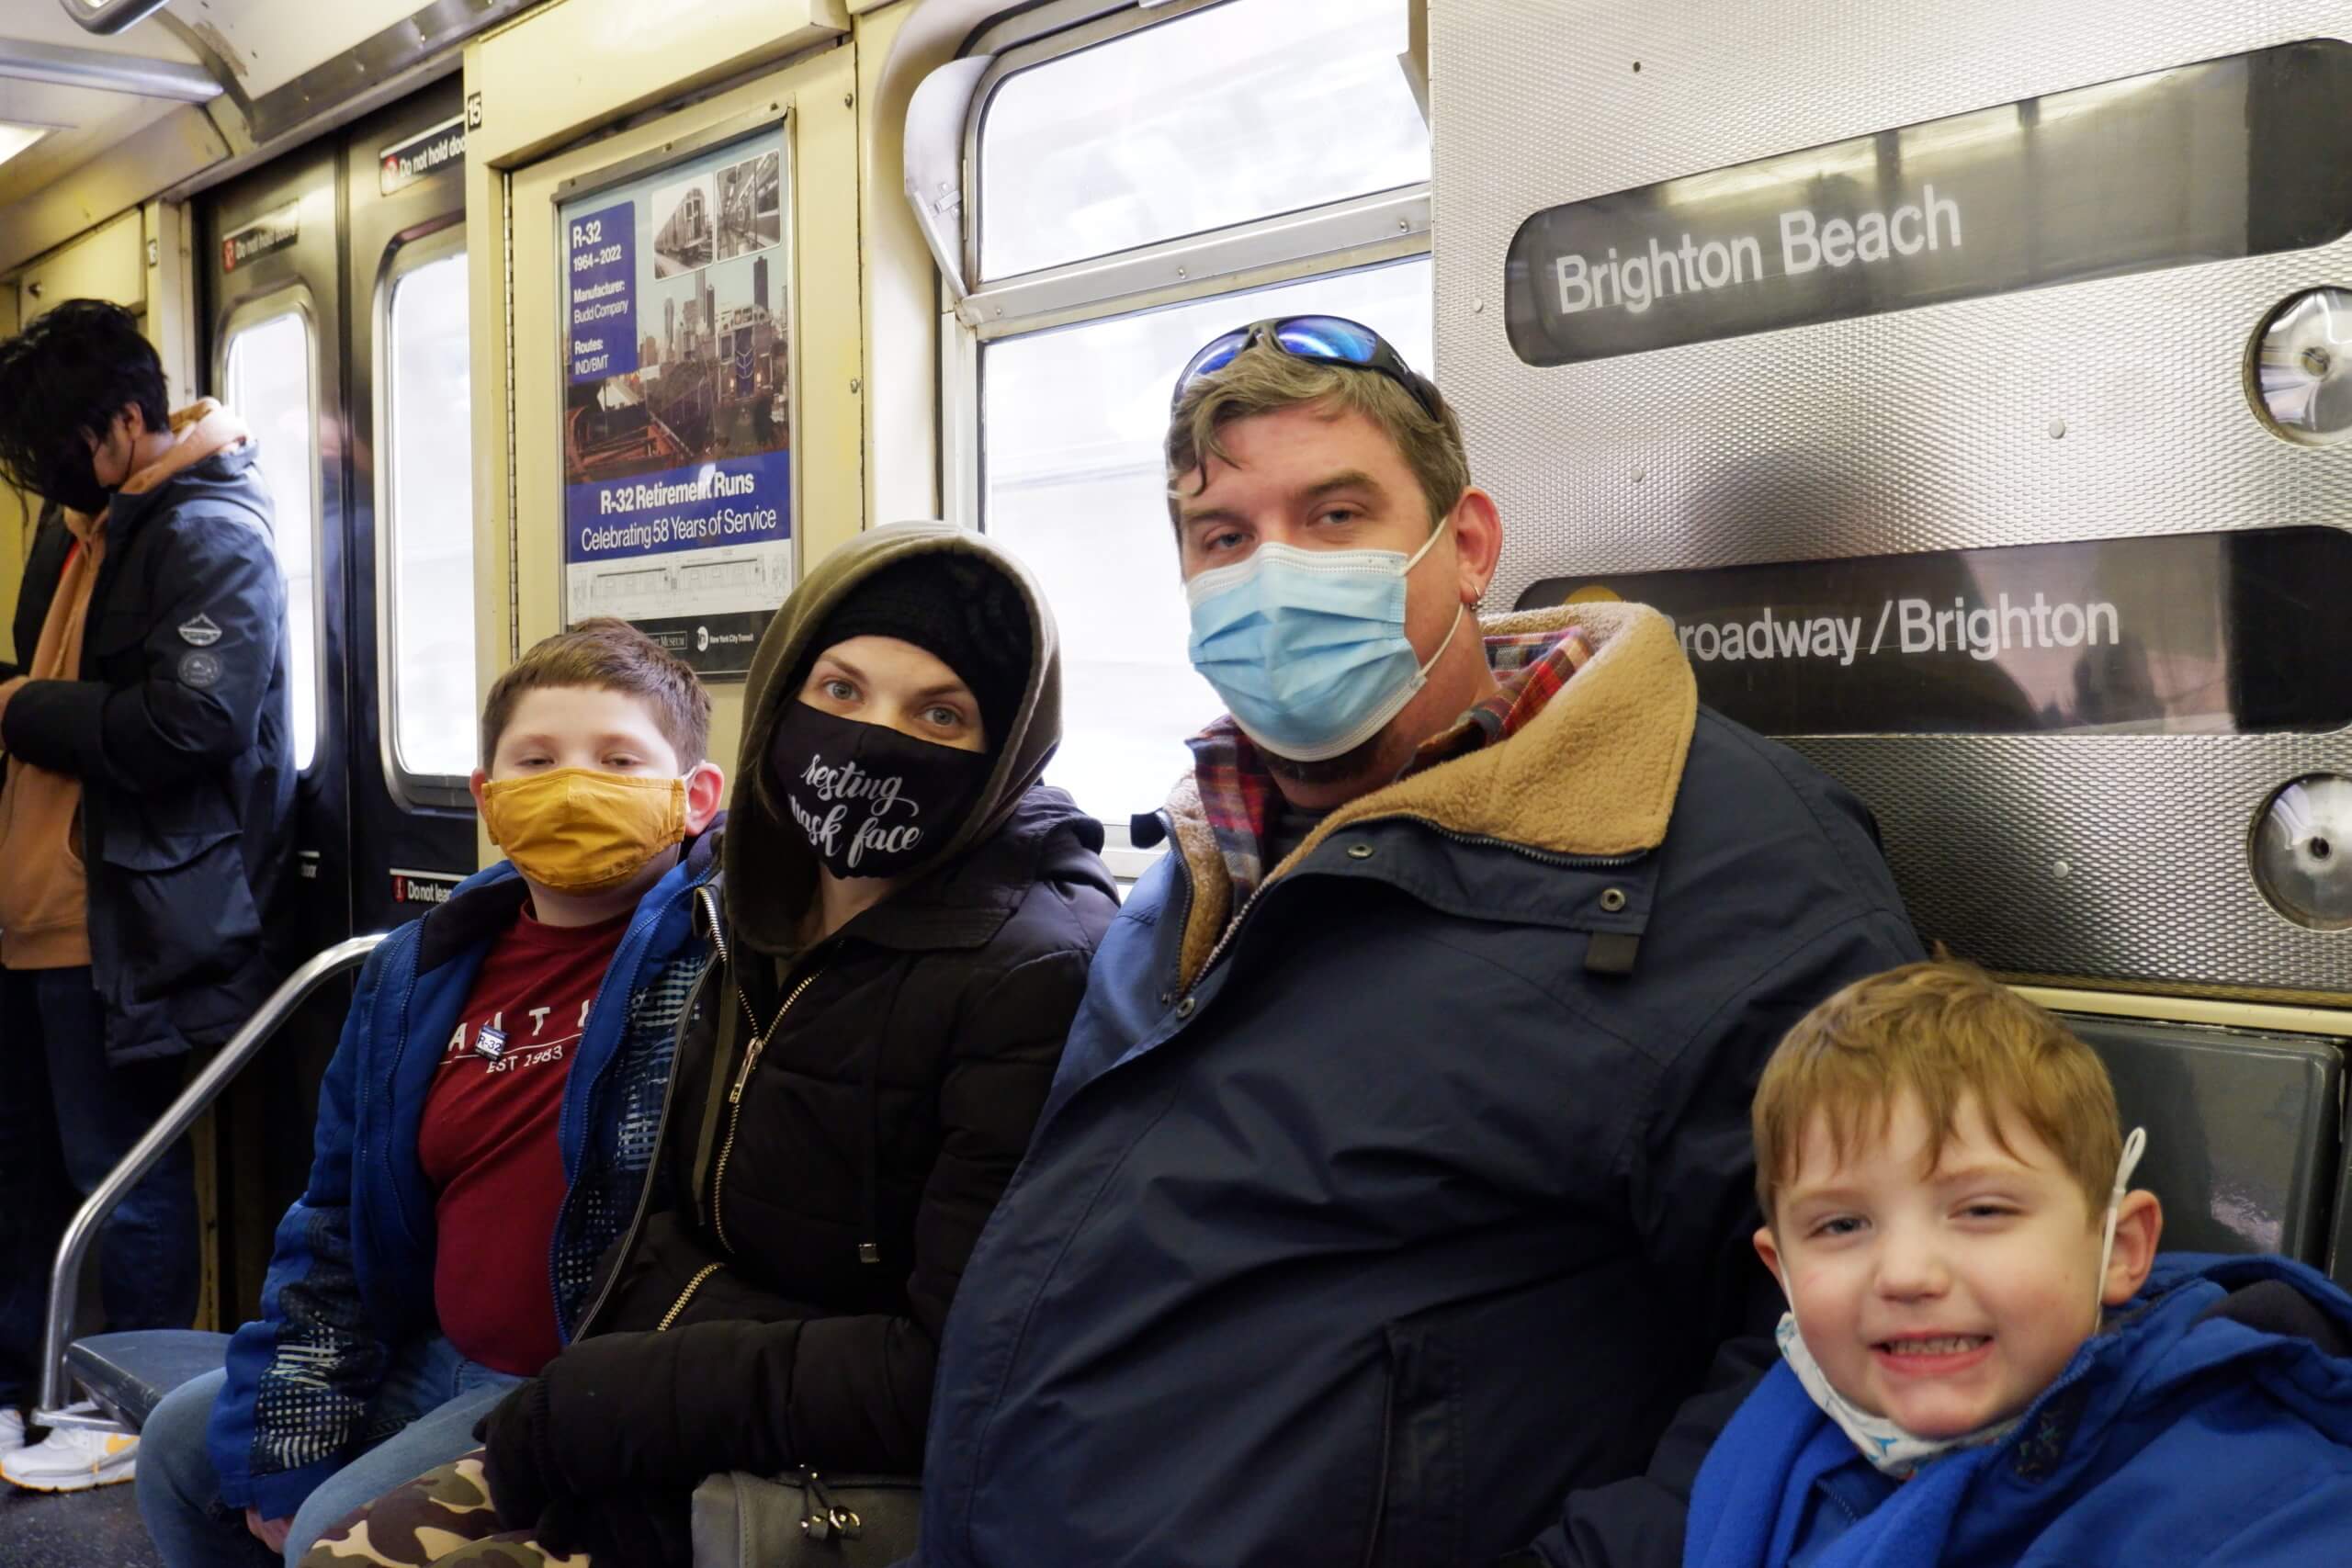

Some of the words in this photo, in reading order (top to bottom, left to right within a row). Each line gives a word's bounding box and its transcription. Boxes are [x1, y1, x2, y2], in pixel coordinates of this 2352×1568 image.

[469, 96, 481, 126] 15
[400, 158, 412, 177] Do
[413, 151, 427, 174] not
[428, 139, 448, 166] hold
[573, 220, 602, 249] R-32
[1556, 232, 1763, 314] Brighton
[1779, 184, 1962, 276] Beach
[573, 252, 594, 273] 1964
[600, 243, 622, 265] 2022
[573, 279, 626, 303] Manufacturer:
[574, 306, 594, 324] Budd
[594, 299, 629, 319] Company
[574, 338, 604, 355] Routes:
[600, 487, 634, 514] R-32
[635, 479, 712, 511] Retirement
[714, 471, 754, 498] Runs
[582, 522, 651, 551] Celebrating
[653, 518, 670, 543] 58
[671, 516, 707, 540] Years
[708, 513, 724, 535] of
[724, 505, 777, 533] Service
[1661, 606, 1861, 666] roadway
[799, 754, 919, 817] resting
[847, 817, 923, 868] face
[408, 880, 419, 900] Do
[420, 883, 434, 902] not
[478, 1035, 503, 1053] R-32
[486, 1056, 518, 1074] EST
[523, 1045, 563, 1067] 1983
